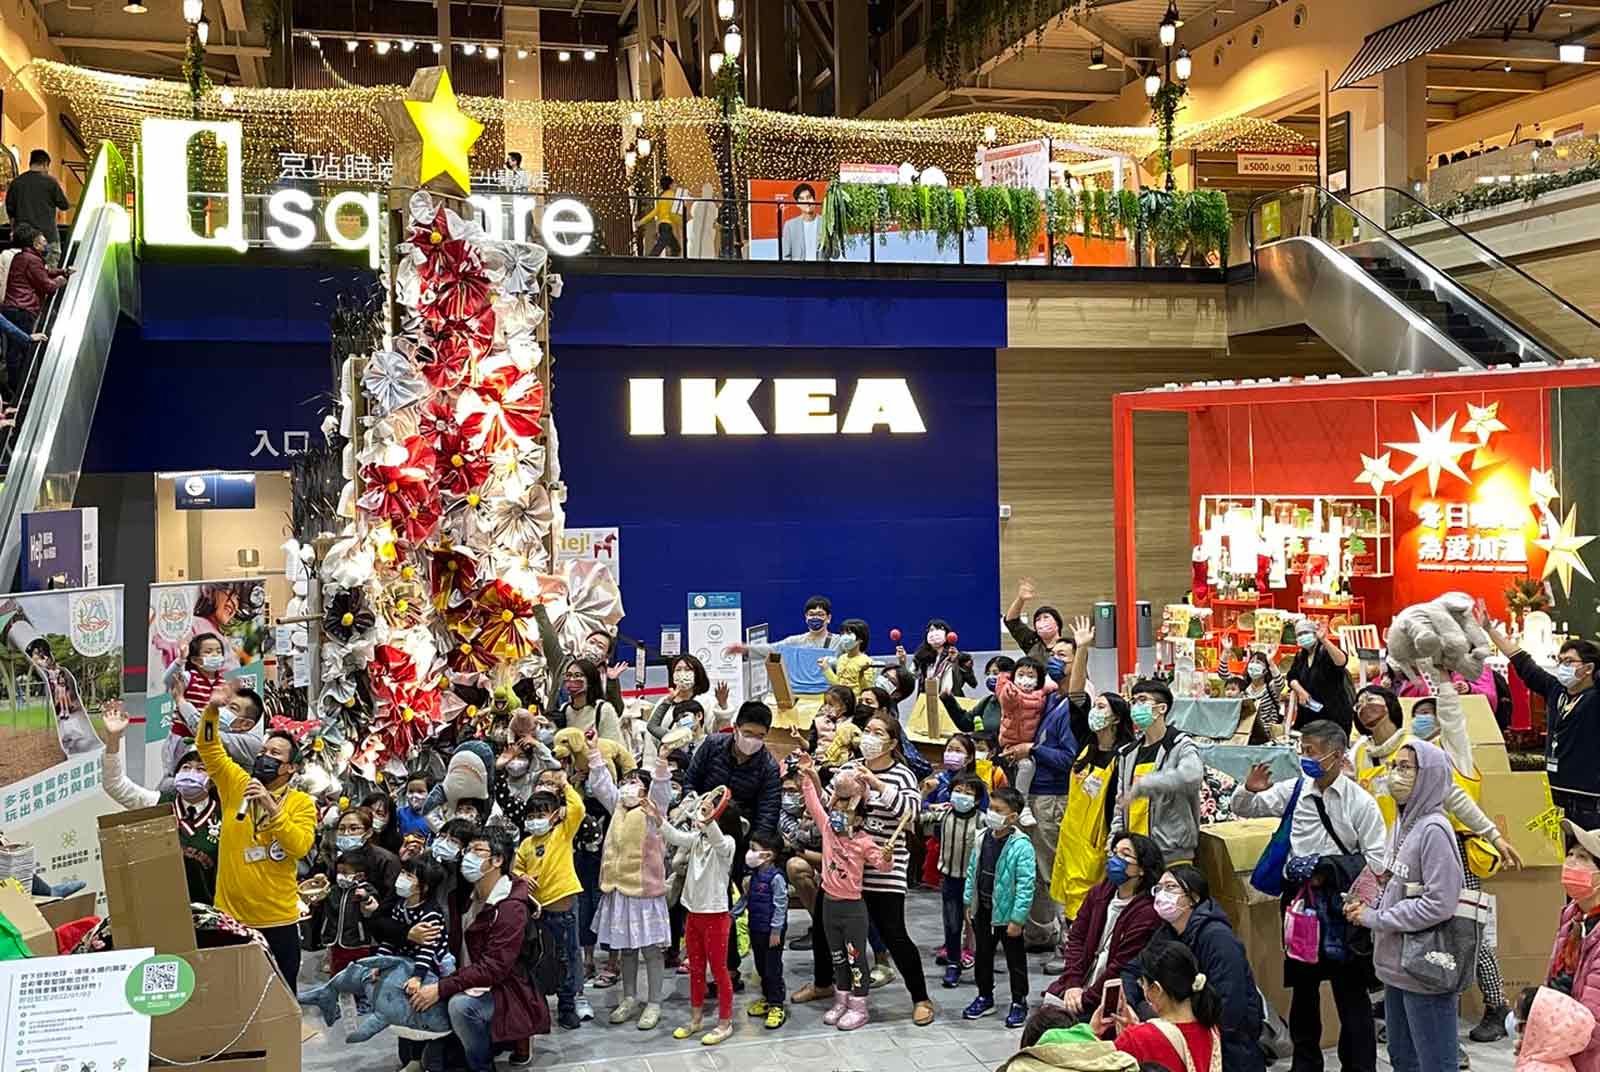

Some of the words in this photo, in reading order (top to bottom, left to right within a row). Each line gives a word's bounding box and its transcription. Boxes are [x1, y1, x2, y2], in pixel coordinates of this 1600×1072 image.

[627, 378, 928, 435] IKEA
[249, 429, 309, 457] 入口
[1417, 501, 1525, 531] 冬日
[5, 757, 103, 808] 多元豐富的遊戲
